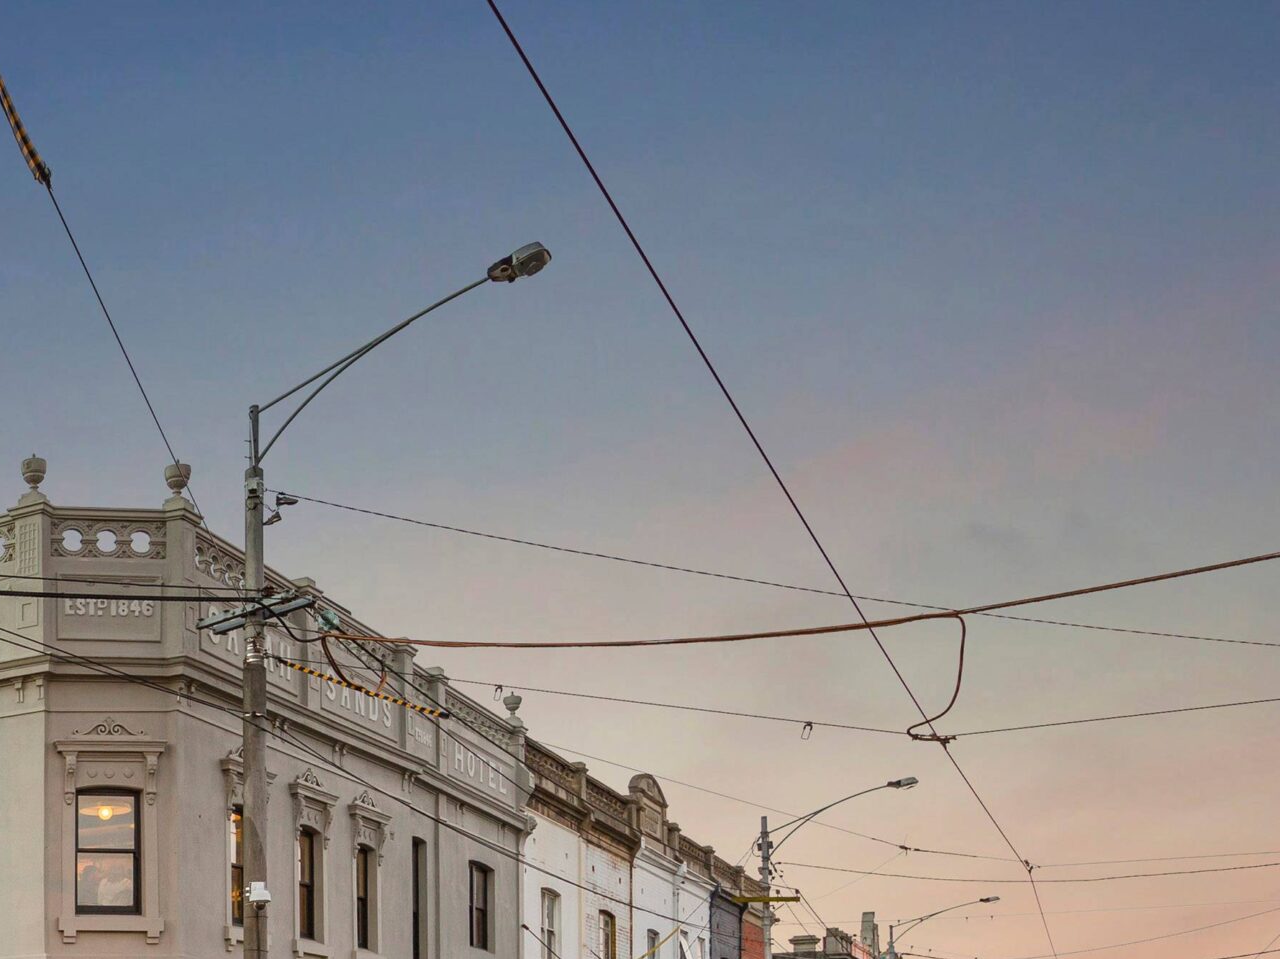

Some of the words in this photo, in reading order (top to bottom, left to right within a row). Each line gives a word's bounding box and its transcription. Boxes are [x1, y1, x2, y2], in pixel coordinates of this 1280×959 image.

[110, 599, 155, 617] 1846
[208, 605, 291, 682] SAAH
[454, 740, 507, 795] HOTEL
